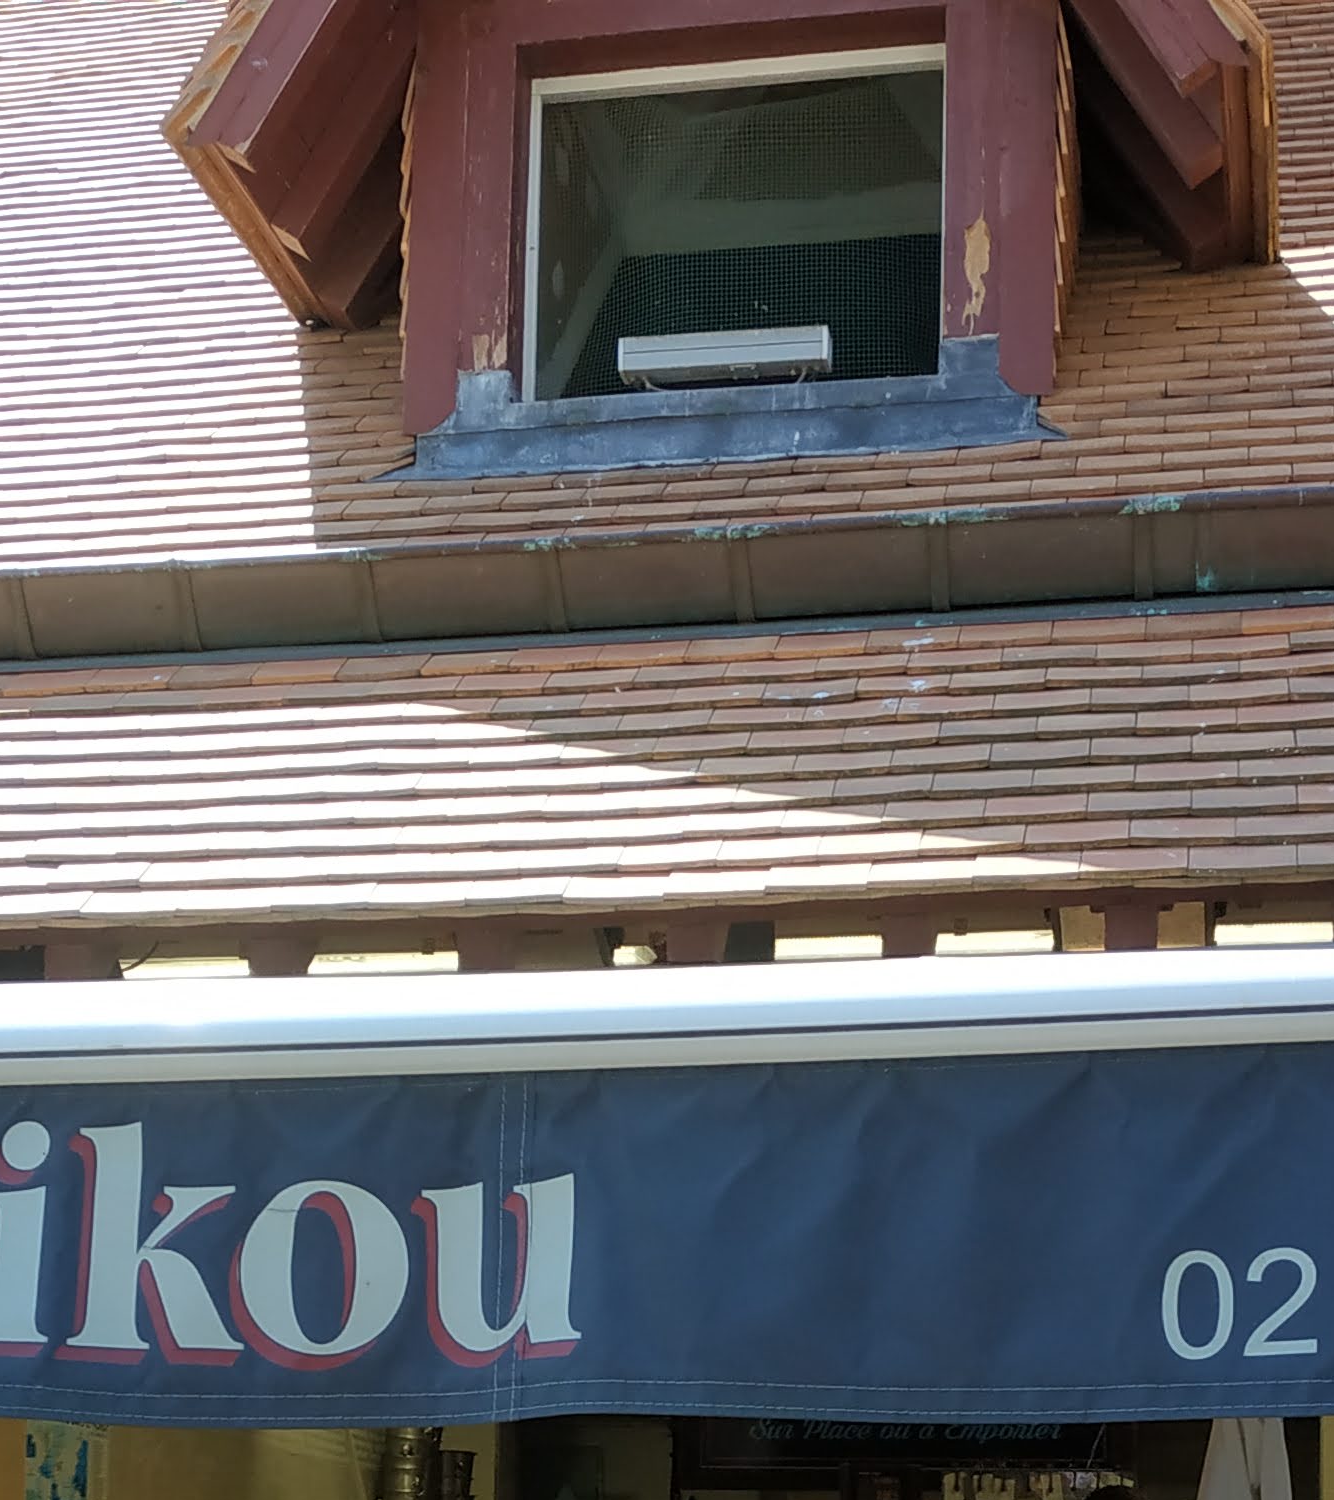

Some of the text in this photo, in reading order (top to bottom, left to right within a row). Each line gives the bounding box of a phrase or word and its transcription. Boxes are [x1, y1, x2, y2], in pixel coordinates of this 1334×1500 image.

[1161, 1247, 1319, 1360] 02
[803, 1419, 868, 1440] Place
[881, 1423, 911, 1440] ou
